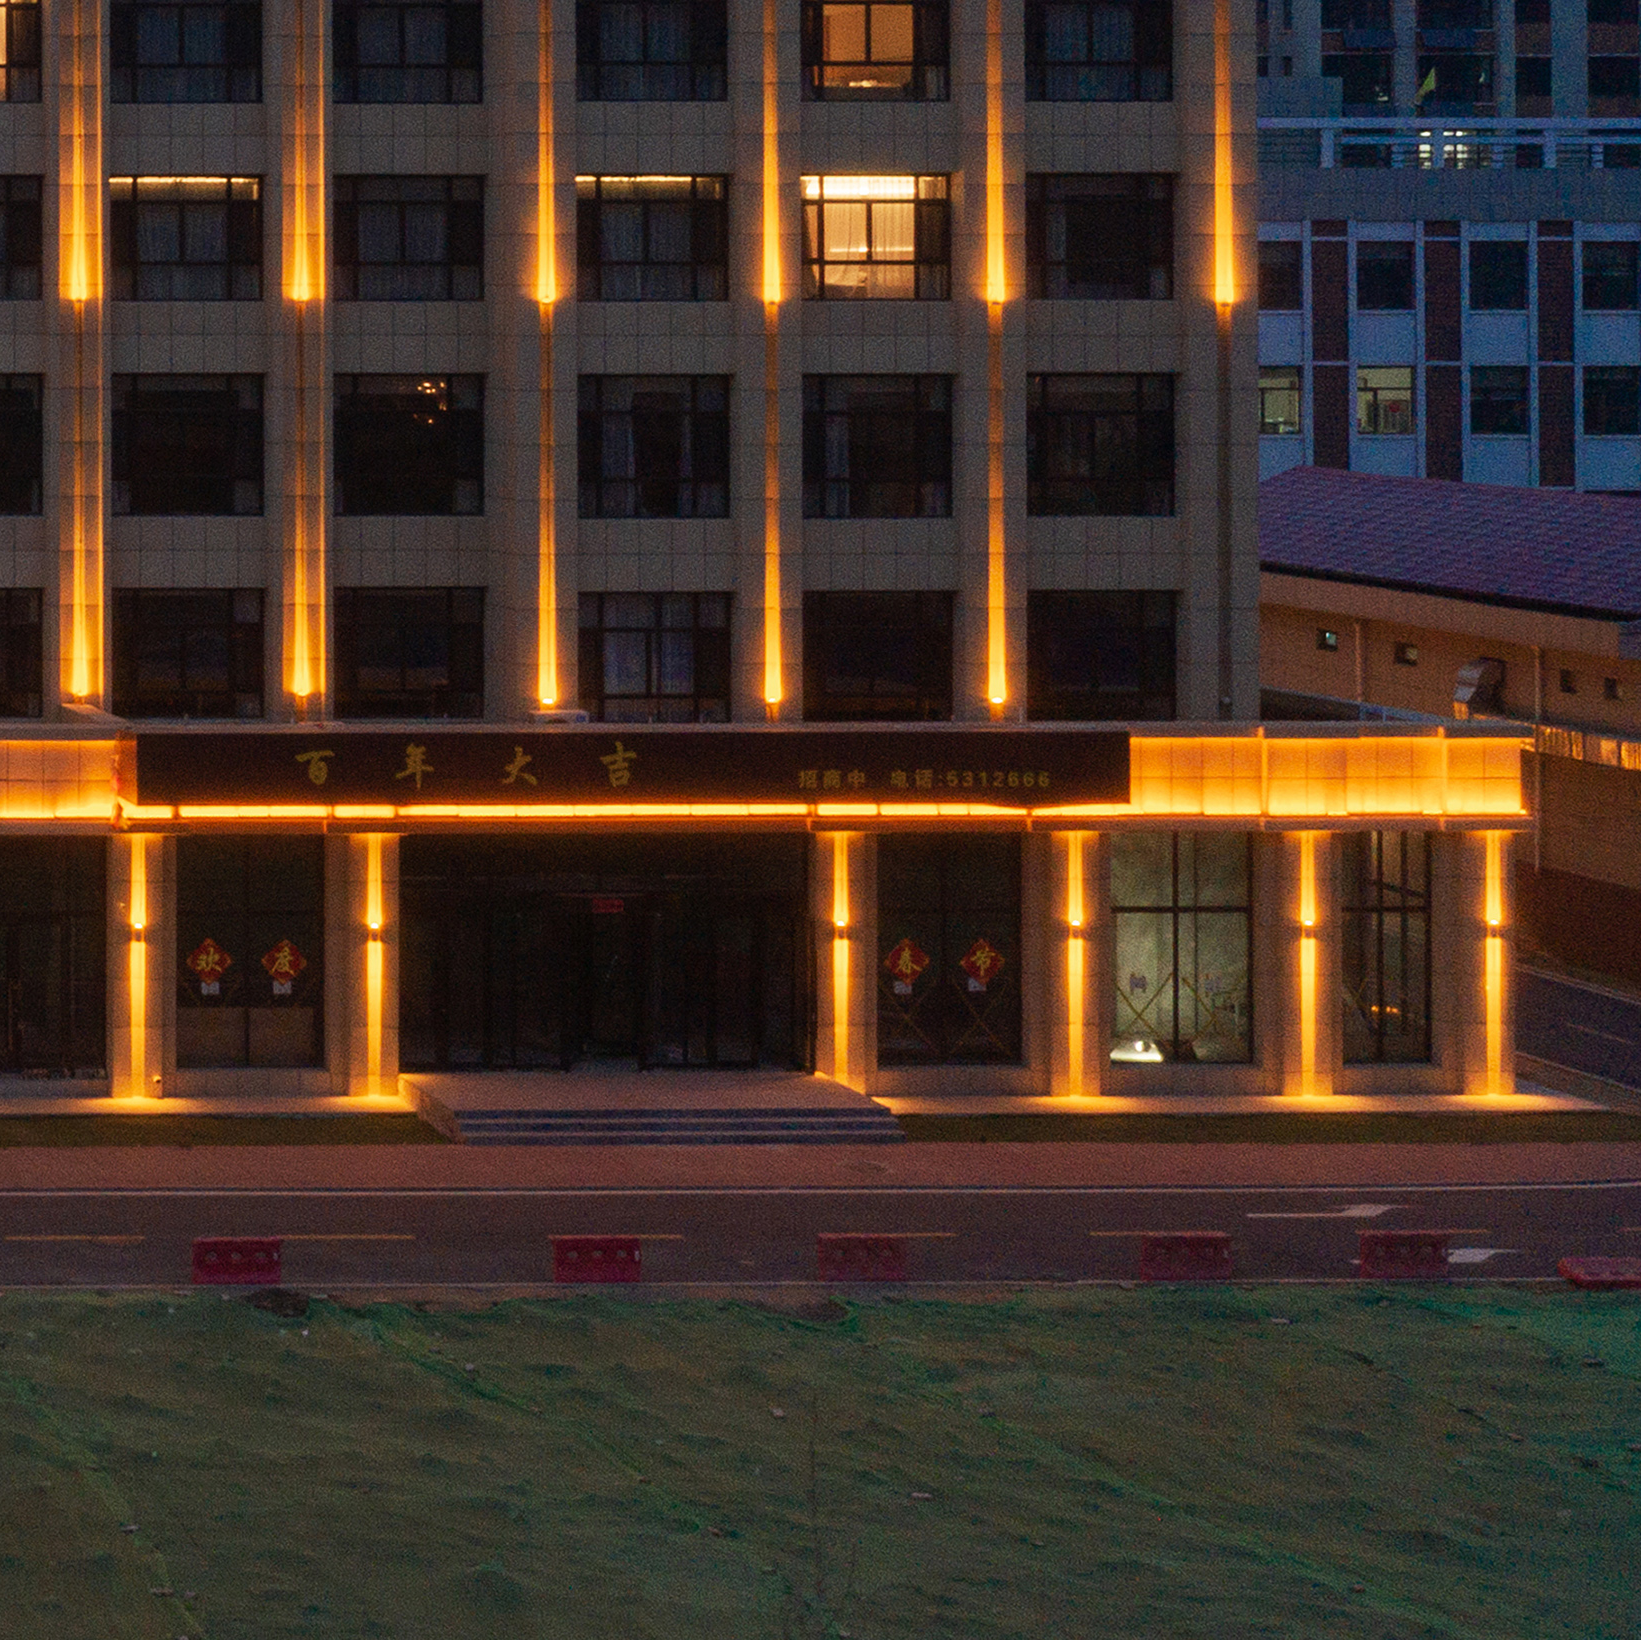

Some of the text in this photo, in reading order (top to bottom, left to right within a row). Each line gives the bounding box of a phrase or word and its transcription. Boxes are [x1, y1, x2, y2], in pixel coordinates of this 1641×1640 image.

[295, 741, 637, 788] 百年大吉
[799, 768, 866, 789] 招商中
[197, 947, 222, 972] 欢
[272, 947, 295, 975] 度
[896, 947, 922, 973] 春
